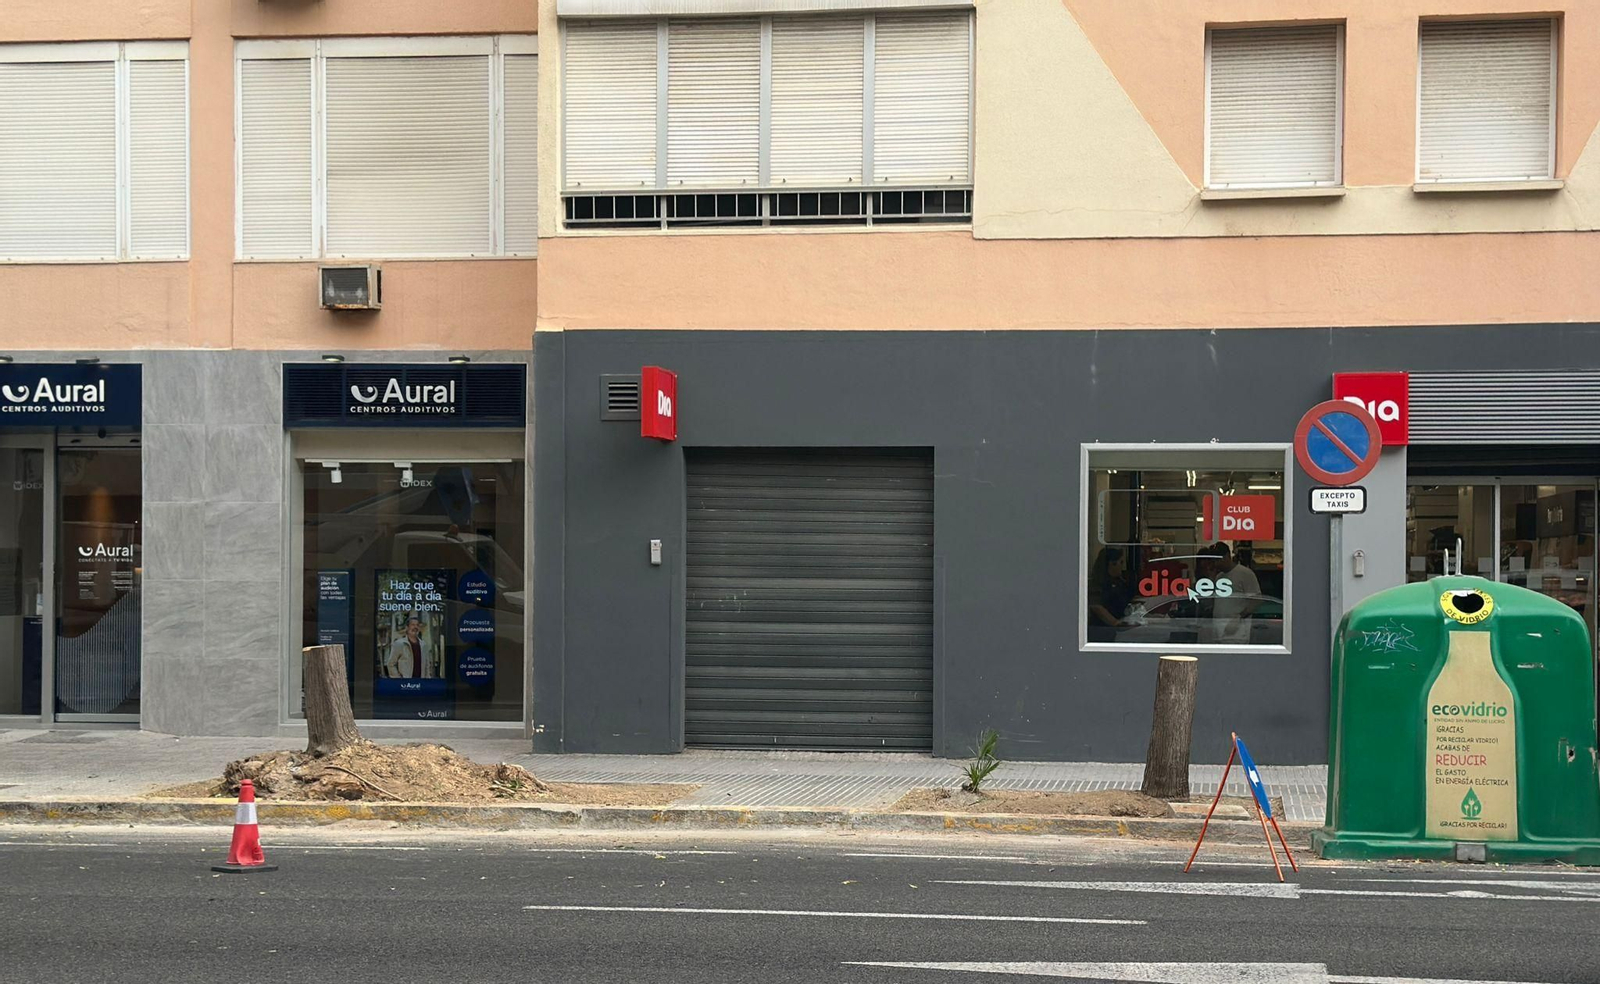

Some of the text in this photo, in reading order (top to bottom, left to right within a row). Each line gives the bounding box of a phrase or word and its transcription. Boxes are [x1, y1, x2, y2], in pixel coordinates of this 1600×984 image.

[33, 377, 105, 403] Aural
[382, 378, 455, 403] Aural
[94, 542, 134, 557] Aural
[390, 580, 434, 592] Haz que
[382, 590, 442, 600] tu día a día
[379, 601, 441, 611] suene bien.
[1446, 608, 1489, 623] DE VIDRIO
[426, 710, 447, 718] Aural
[1432, 701, 1508, 717] ecovidrio
[1435, 754, 1487, 766] REDUCIR
[1435, 768, 1443, 776] EL
[1435, 776, 1509, 786] EN ENERGÍA ELÉCTRICA
